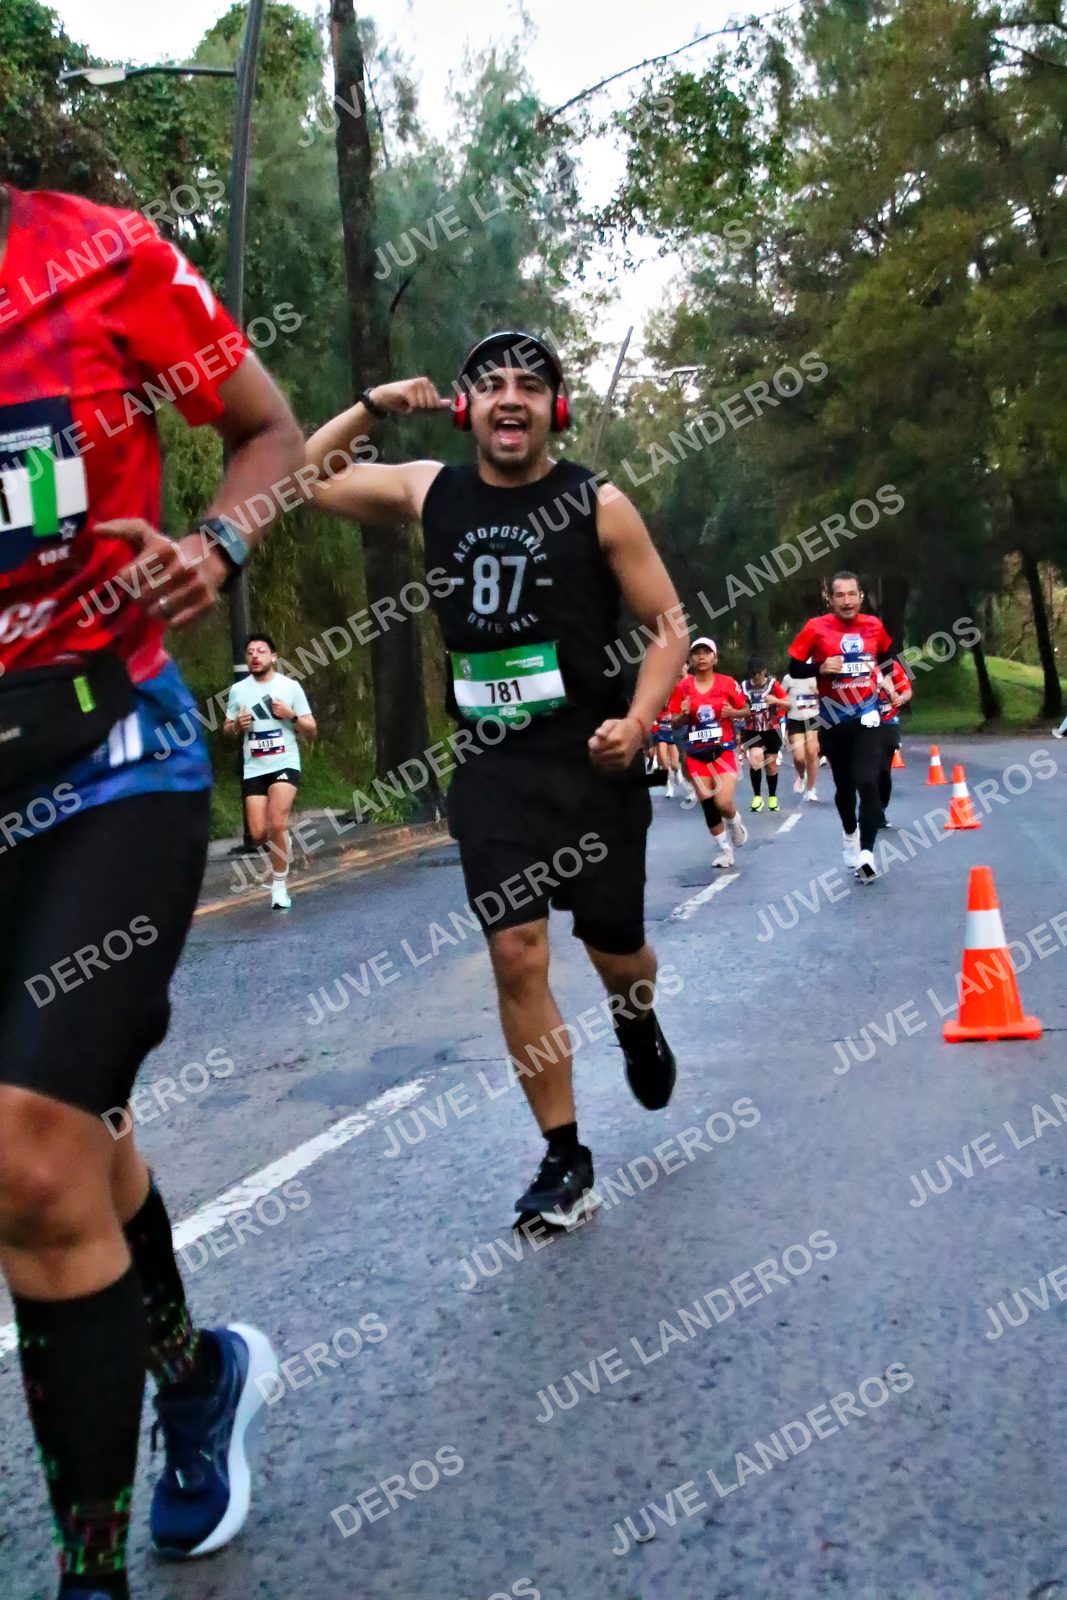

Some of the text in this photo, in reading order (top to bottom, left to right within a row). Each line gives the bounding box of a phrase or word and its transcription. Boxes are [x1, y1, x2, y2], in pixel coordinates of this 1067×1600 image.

[453, 525, 547, 564] AEROPOSTALE
[472, 554, 527, 615] 87
[485, 679, 522, 704] 781
